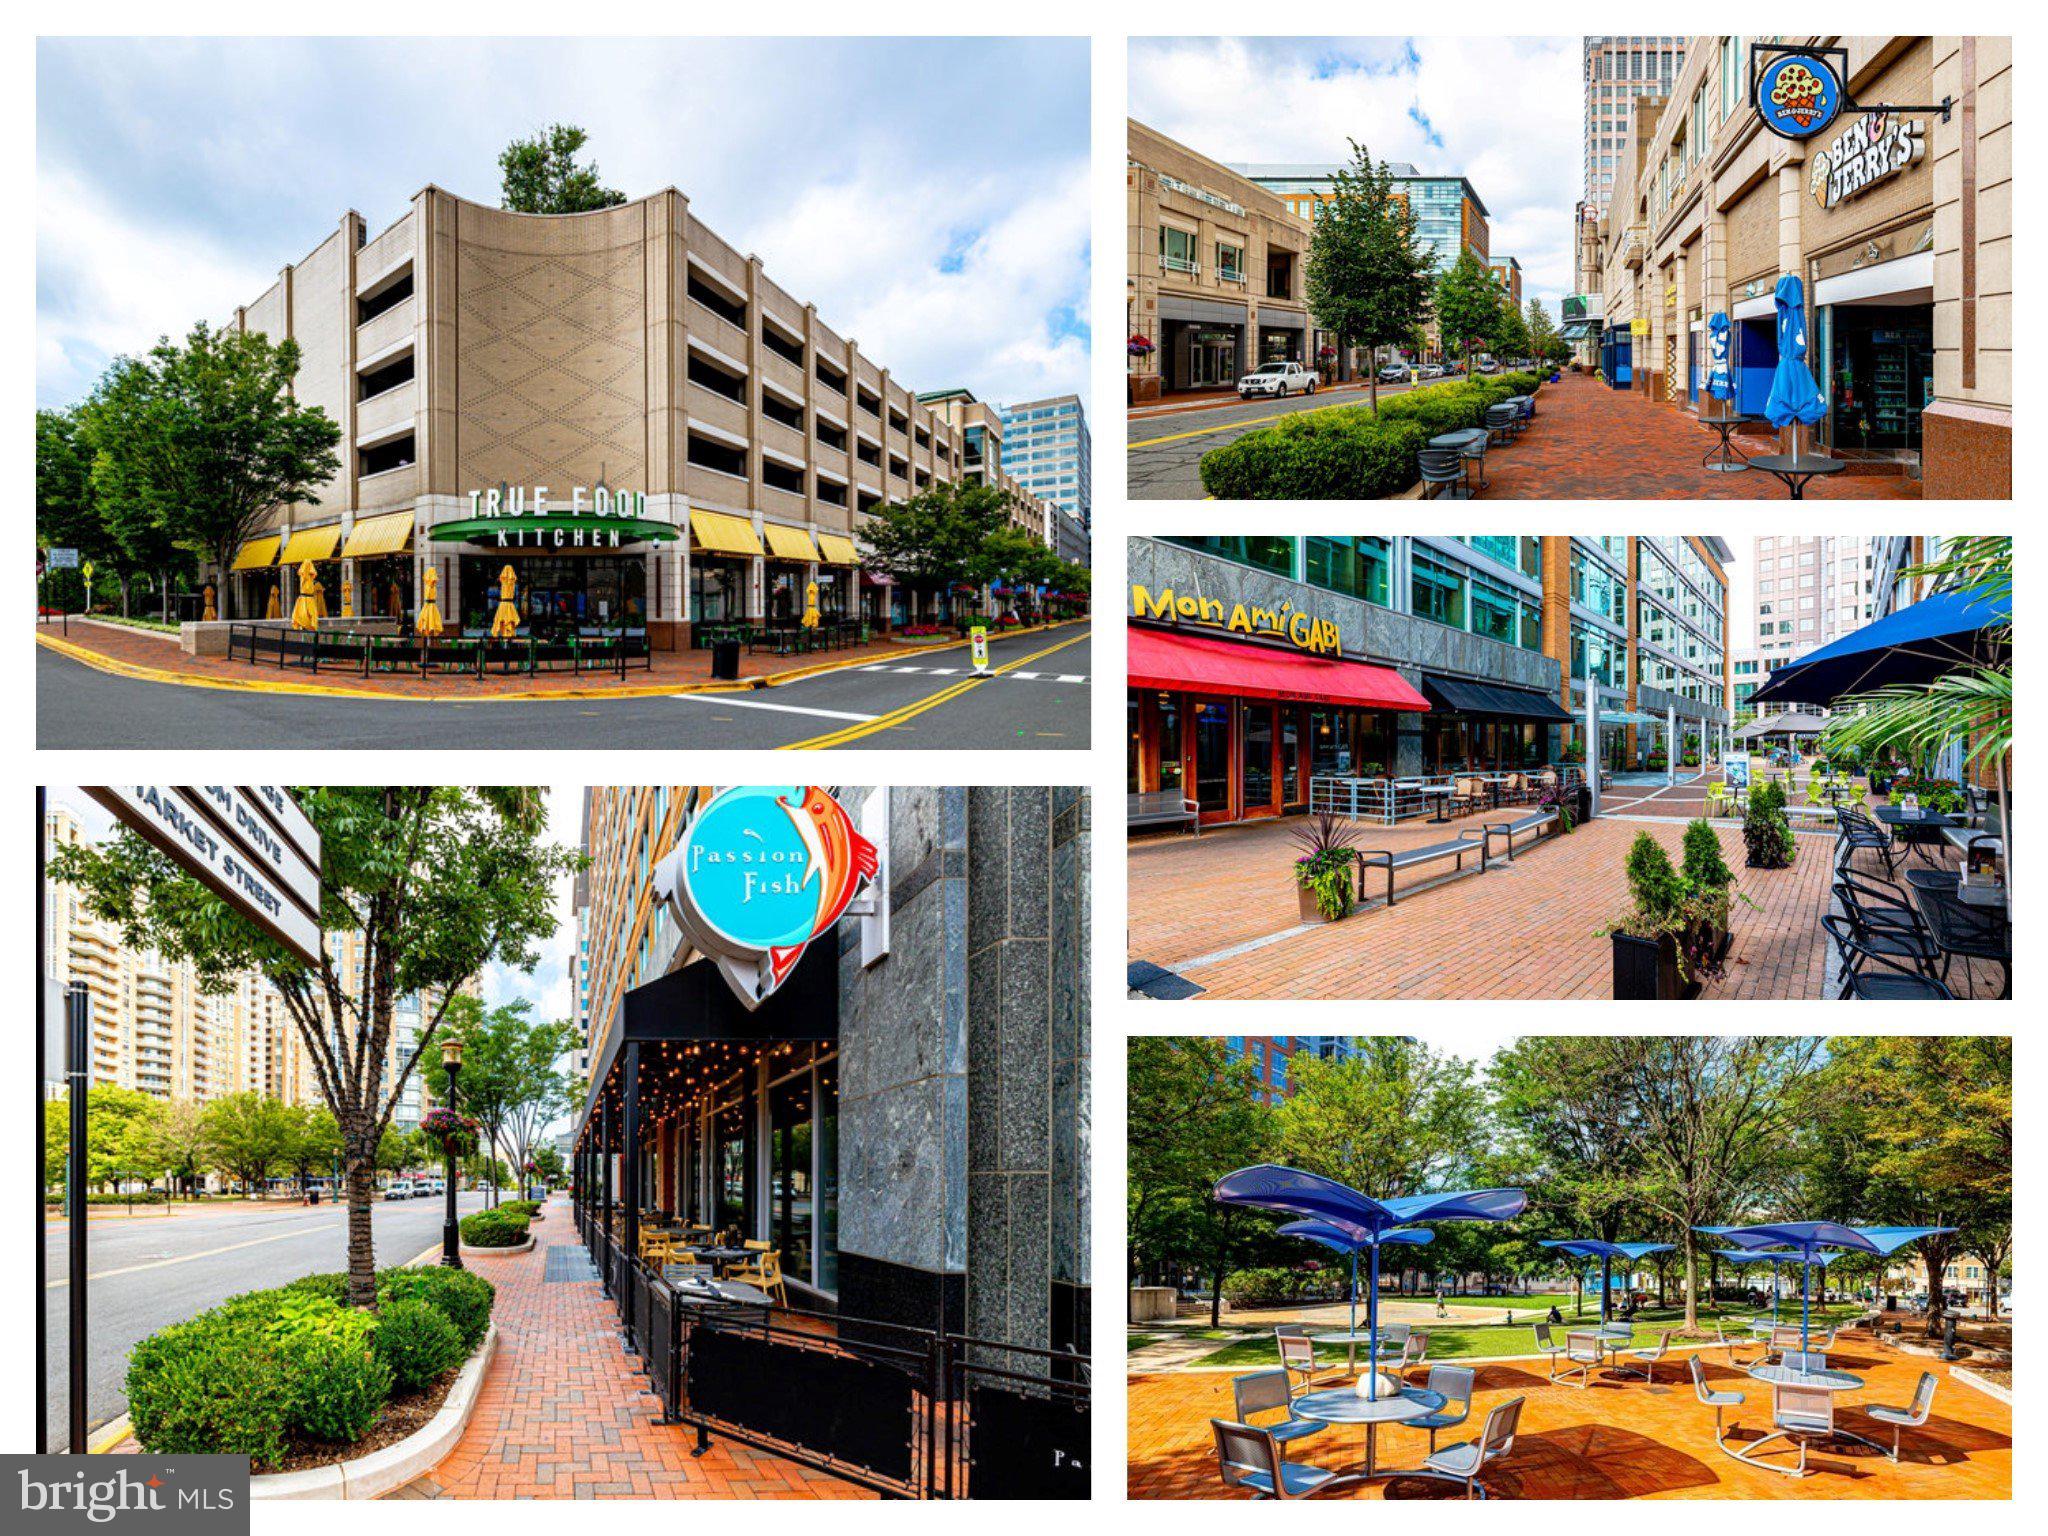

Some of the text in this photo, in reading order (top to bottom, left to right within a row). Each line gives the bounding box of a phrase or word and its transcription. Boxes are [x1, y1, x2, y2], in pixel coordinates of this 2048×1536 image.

[1828, 120, 1914, 204] JERRY'S
[1831, 113, 1869, 171] BEN
[468, 486, 648, 518] TRUE FOOD
[497, 528, 620, 548] KITCHEN
[1132, 584, 1223, 624] Mon
[136, 786, 281, 917] ARKET STREET
[236, 803, 281, 865] DRIVE
[692, 844, 804, 873] Passion
[742, 871, 800, 905] Fish
